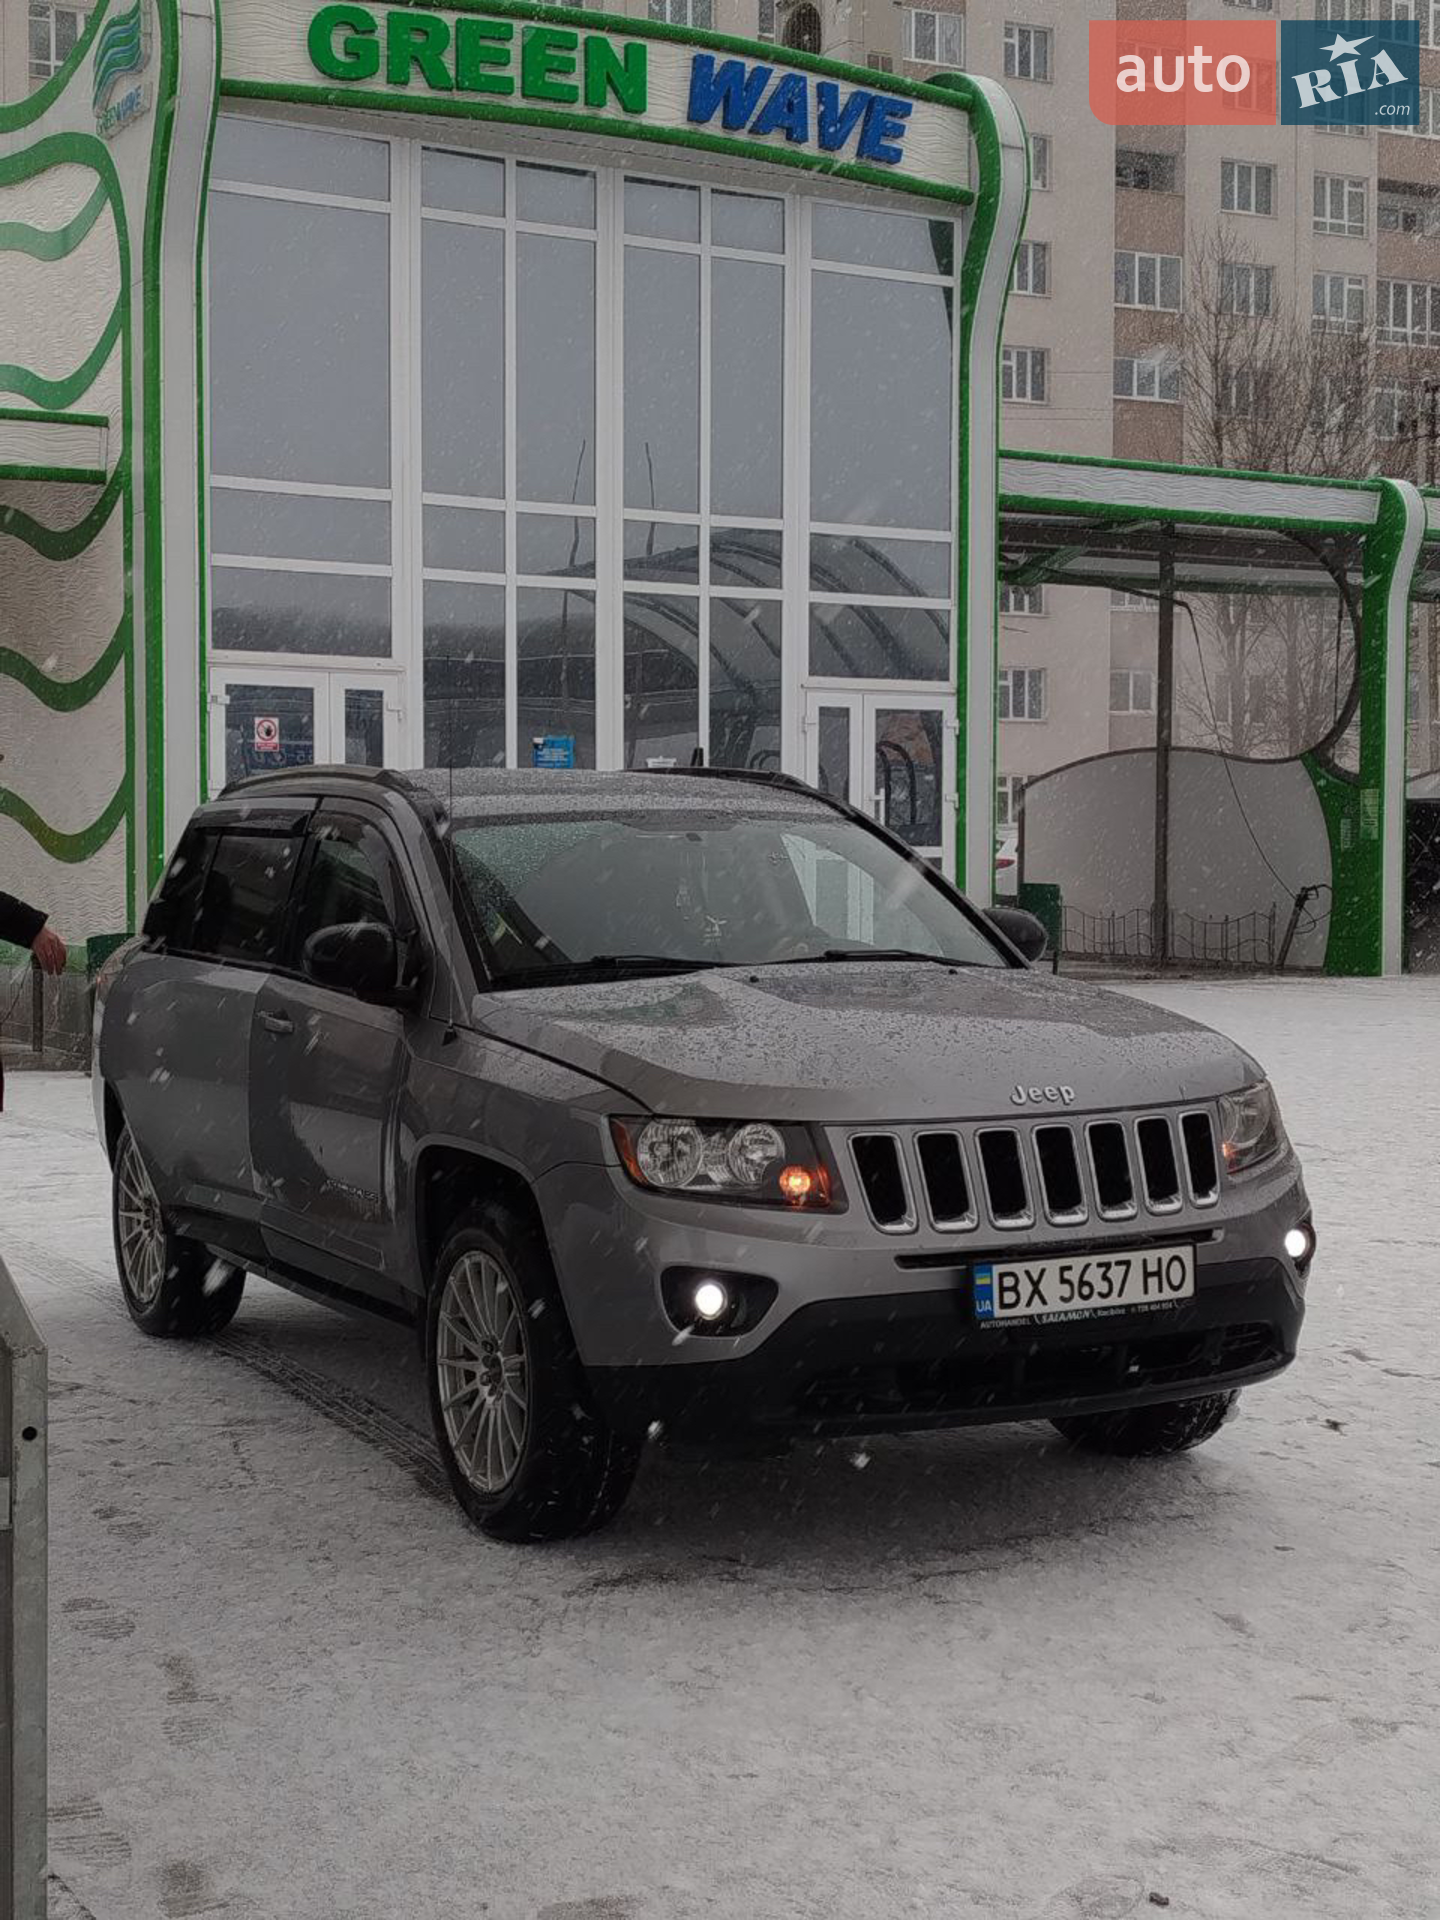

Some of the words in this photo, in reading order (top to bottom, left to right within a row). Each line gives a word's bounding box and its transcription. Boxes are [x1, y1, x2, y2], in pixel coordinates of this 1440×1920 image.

[308, 4, 647, 115] GREEN
[686, 53, 913, 165] WAVE
[1010, 1085, 1076, 1105] Jeep
[998, 1267, 1048, 1310] BX
[1059, 1259, 1132, 1304] 5637
[1142, 1254, 1187, 1296] HO
[976, 1299, 992, 1312] UA
